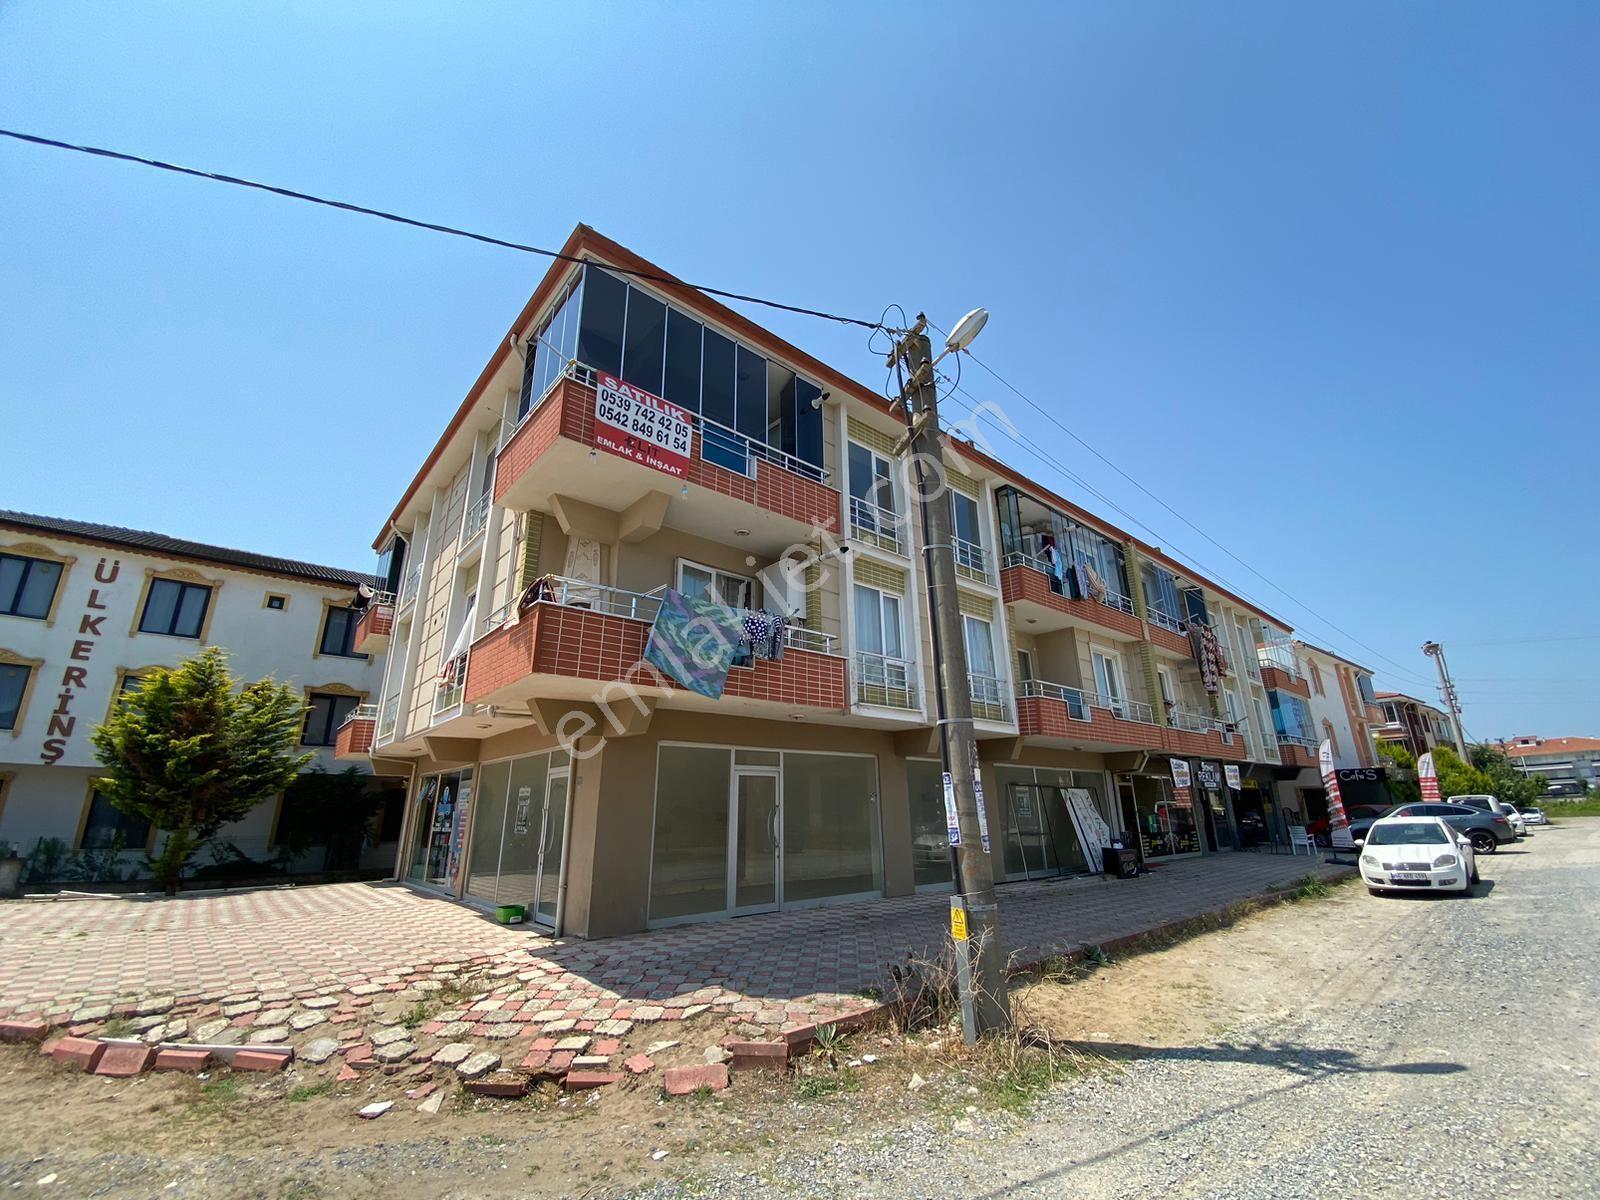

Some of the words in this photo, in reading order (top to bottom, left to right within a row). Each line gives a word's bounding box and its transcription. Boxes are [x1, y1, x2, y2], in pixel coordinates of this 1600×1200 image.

[601, 389, 631, 412] 0539
[635, 403, 656, 423] 742
[658, 416, 672, 431] 42
[675, 422, 688, 438] 05
[604, 376, 685, 422] SATILIK
[597, 435, 633, 457] EMLAK
[635, 452, 643, 461] &
[599, 404, 629, 428] 0542
[632, 419, 653, 438] 849
[656, 429, 669, 446] 61
[673, 437, 687, 453] 54
